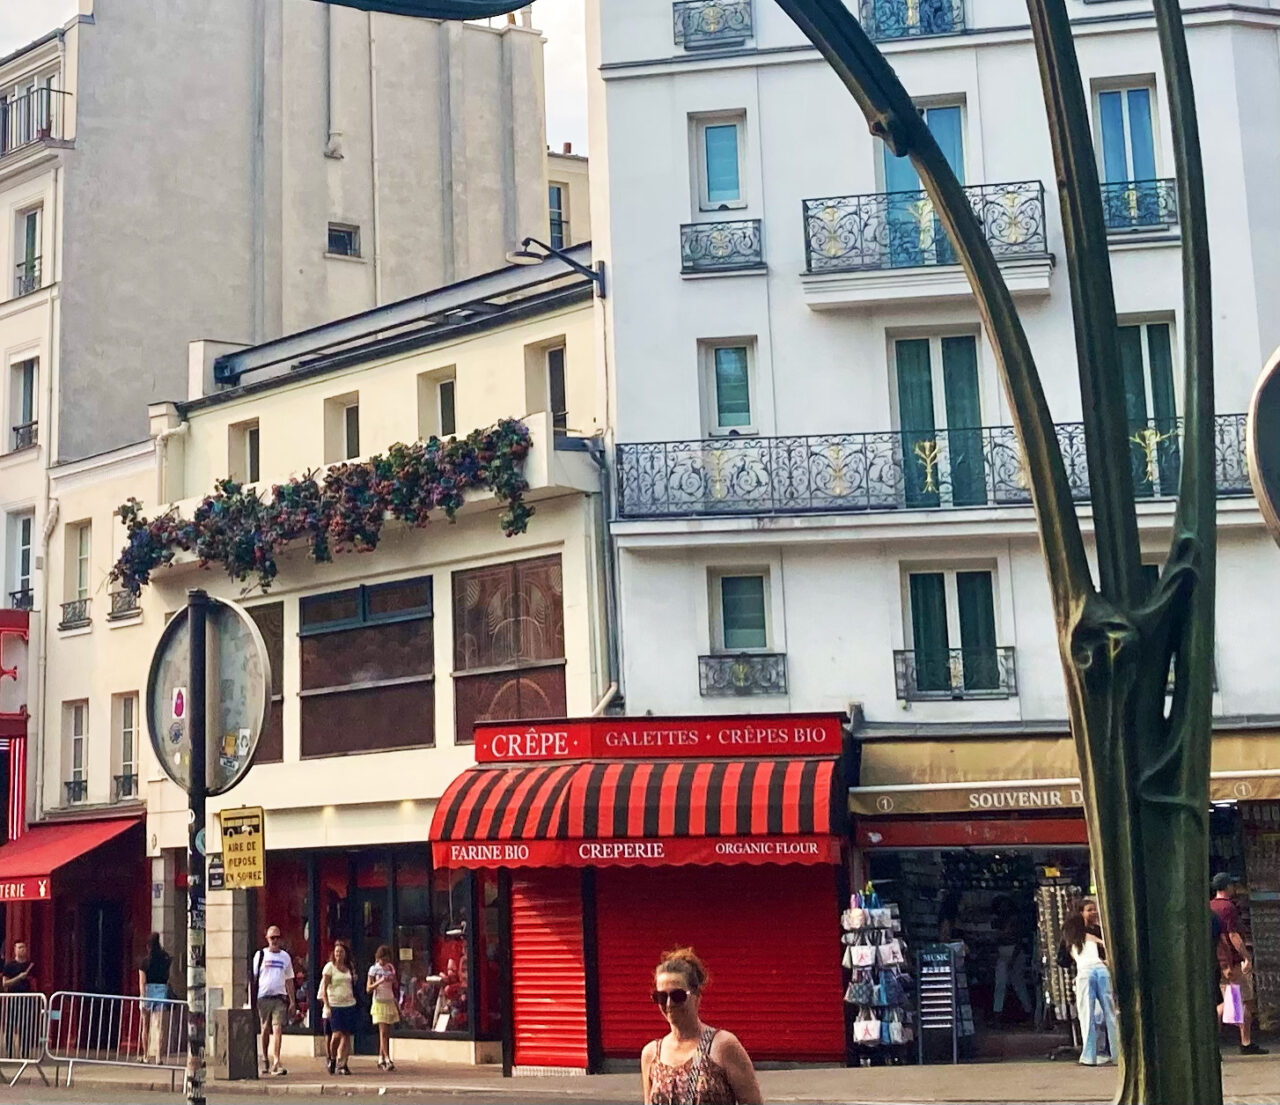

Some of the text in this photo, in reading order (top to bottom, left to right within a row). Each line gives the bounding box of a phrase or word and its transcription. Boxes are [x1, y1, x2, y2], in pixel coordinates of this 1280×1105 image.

[491, 726, 826, 757] CRÊPE GALETTES CRÊPES BIO
[969, 791, 1062, 808] SOUVENIR
[246, 841, 257, 851] DE
[451, 845, 529, 860] FARINE BIO
[579, 842, 665, 859] CREPERIE
[715, 841, 818, 855] ORGANIC FLOUR
[922, 953, 949, 962] MUSIC
